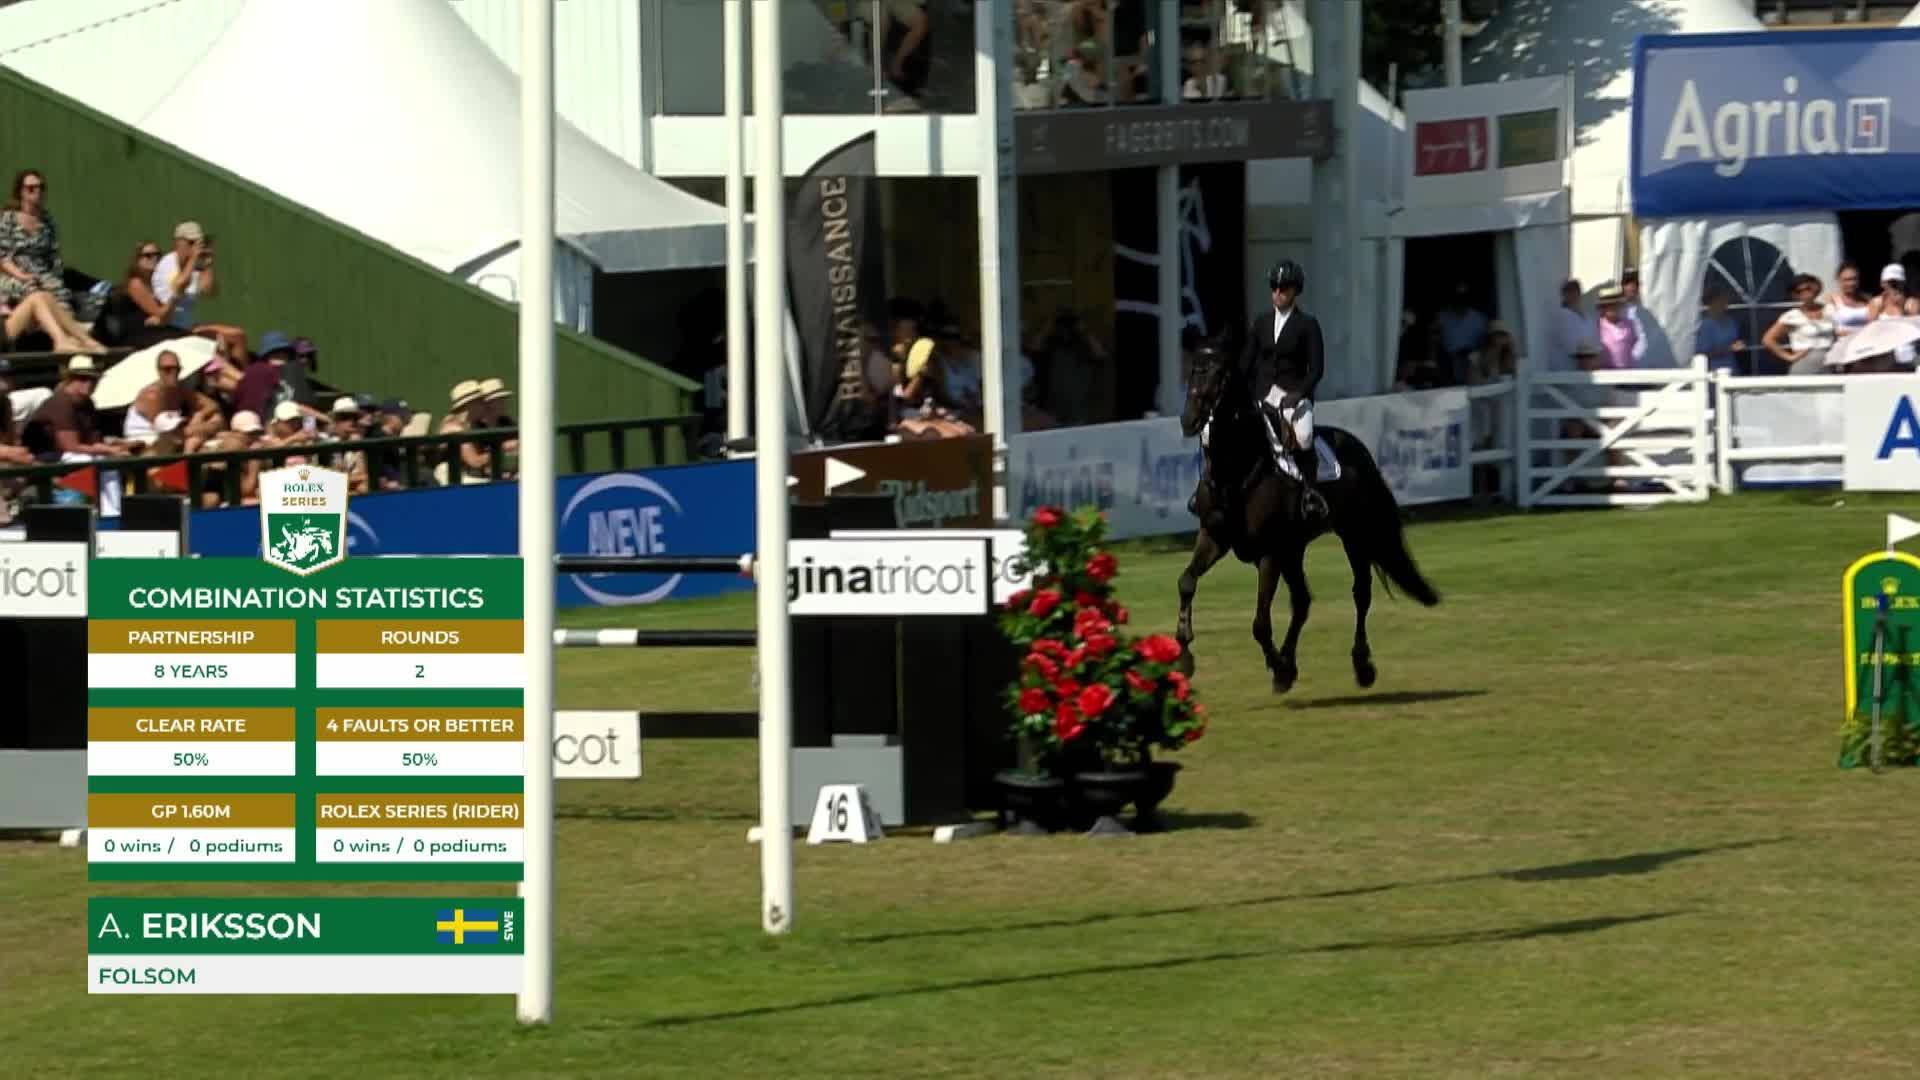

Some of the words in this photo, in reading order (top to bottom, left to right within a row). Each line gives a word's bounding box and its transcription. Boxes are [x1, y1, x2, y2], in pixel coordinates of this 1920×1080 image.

[1661, 75, 1840, 178] Agria
[820, 176, 862, 401] RENAISSANCE
[1875, 393, 1920, 460] A
[0, 557, 78, 597] icot
[827, 792, 848, 832] 16
